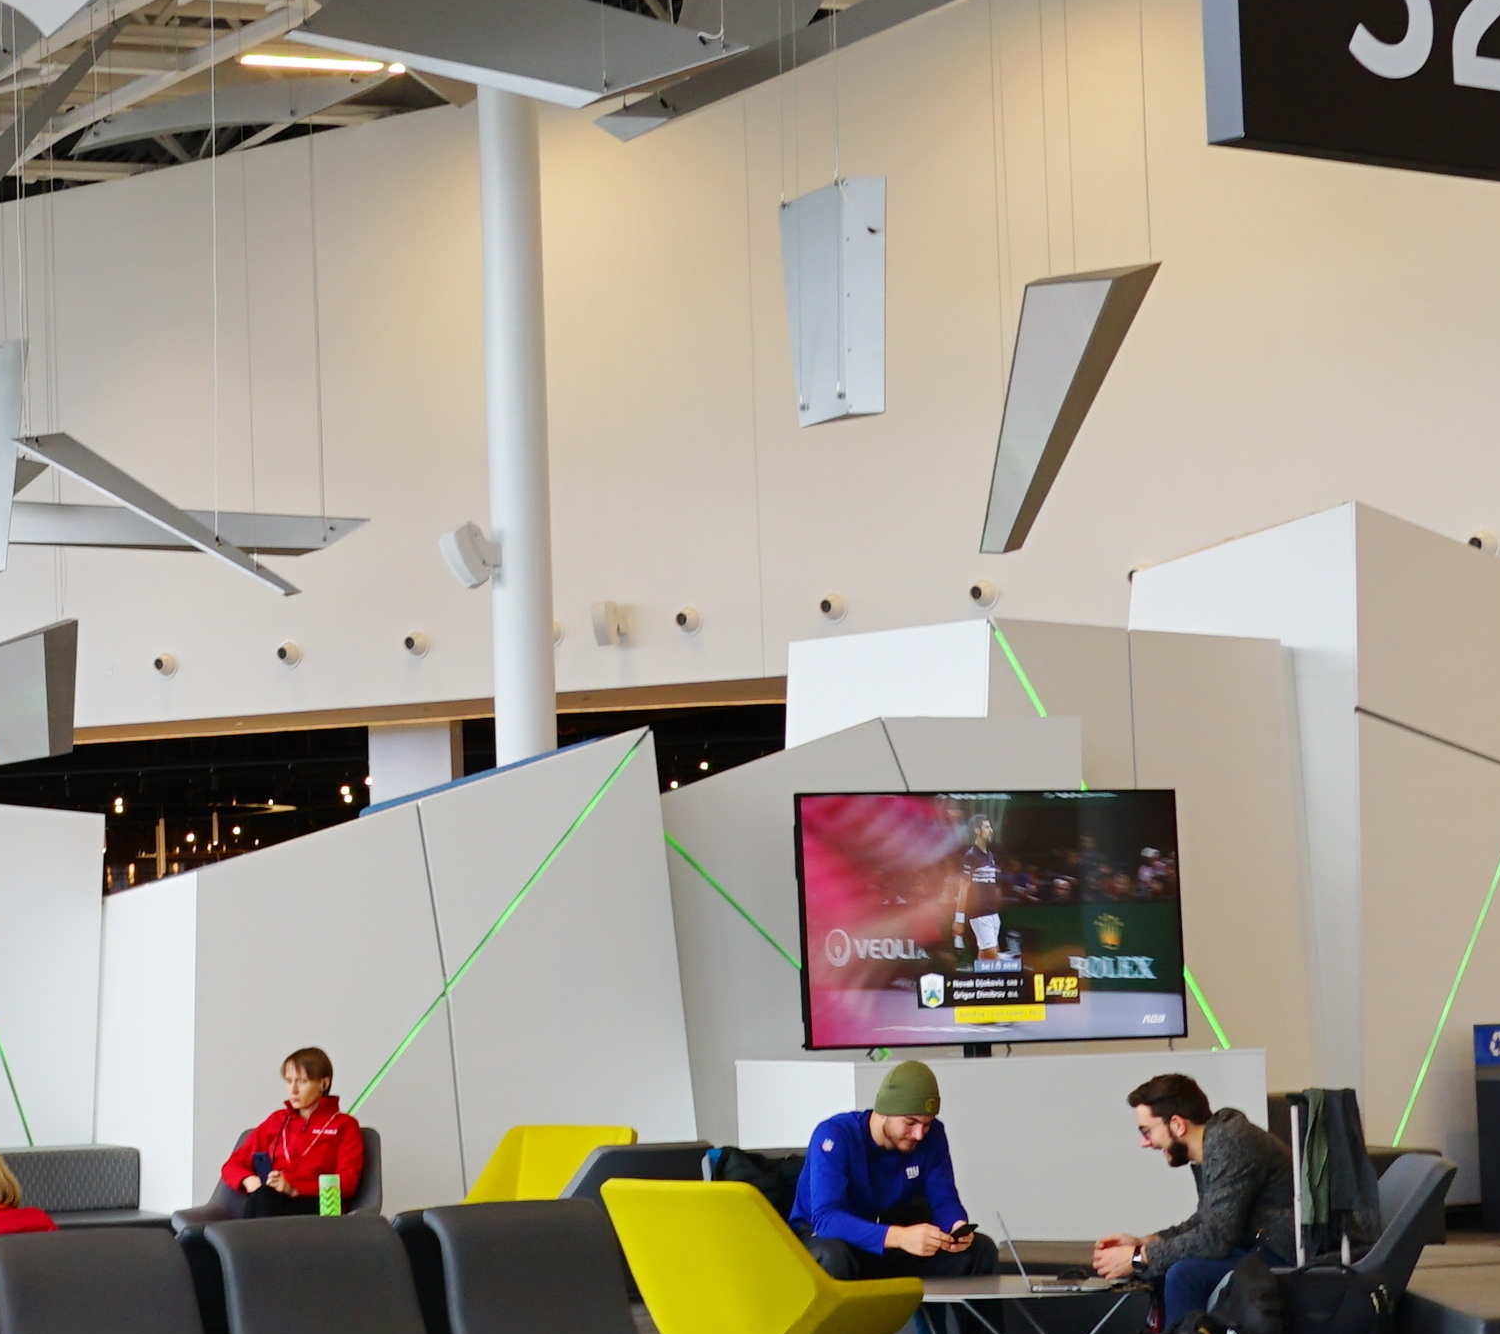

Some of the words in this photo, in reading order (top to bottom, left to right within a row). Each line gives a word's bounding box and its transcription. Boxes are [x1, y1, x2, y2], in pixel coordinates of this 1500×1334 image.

[852, 937, 931, 961] VEOLIA
[1068, 955, 1158, 980] ROLEX
[1047, 976, 1078, 991] ATP
